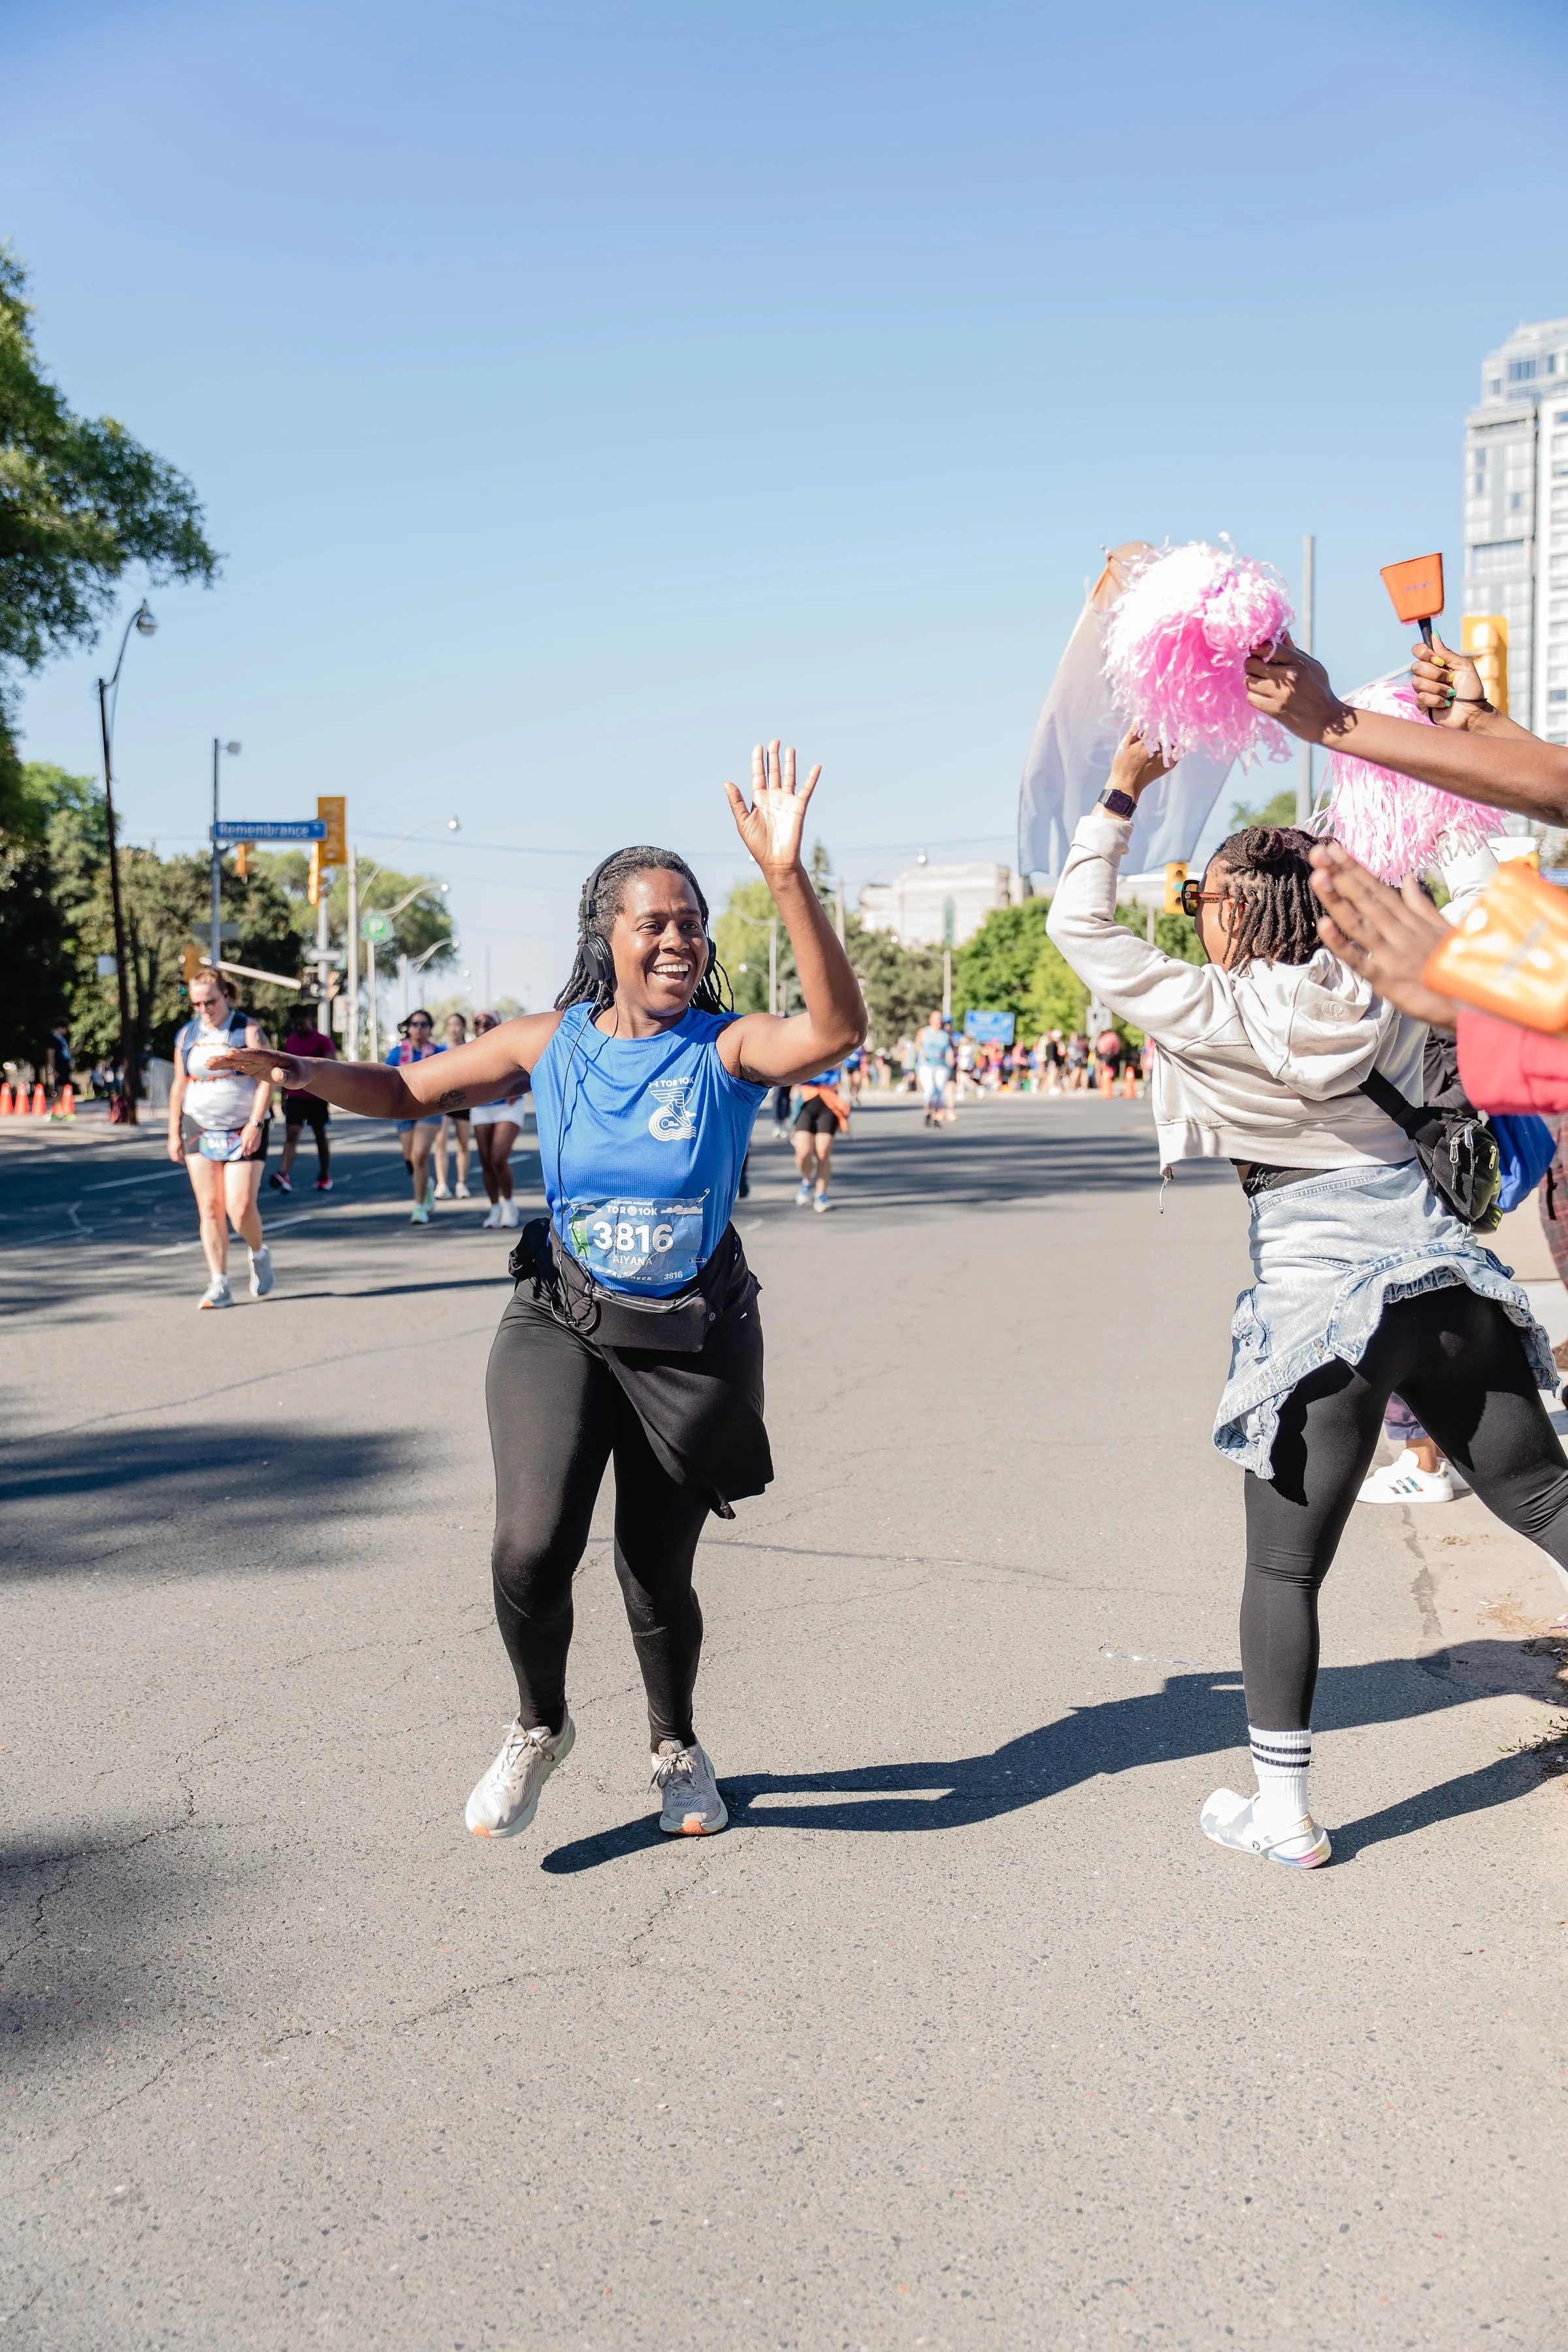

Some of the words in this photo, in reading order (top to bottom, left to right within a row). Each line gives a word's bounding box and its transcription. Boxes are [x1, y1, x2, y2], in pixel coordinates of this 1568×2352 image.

[219, 823, 310, 837] Remembrance
[370, 919, 384, 934] P
[638, 1207, 658, 1216] 10K
[593, 1220, 674, 1253] 3816
[612, 1255, 653, 1266] AIYANA
[664, 1271, 683, 1281] 3816
